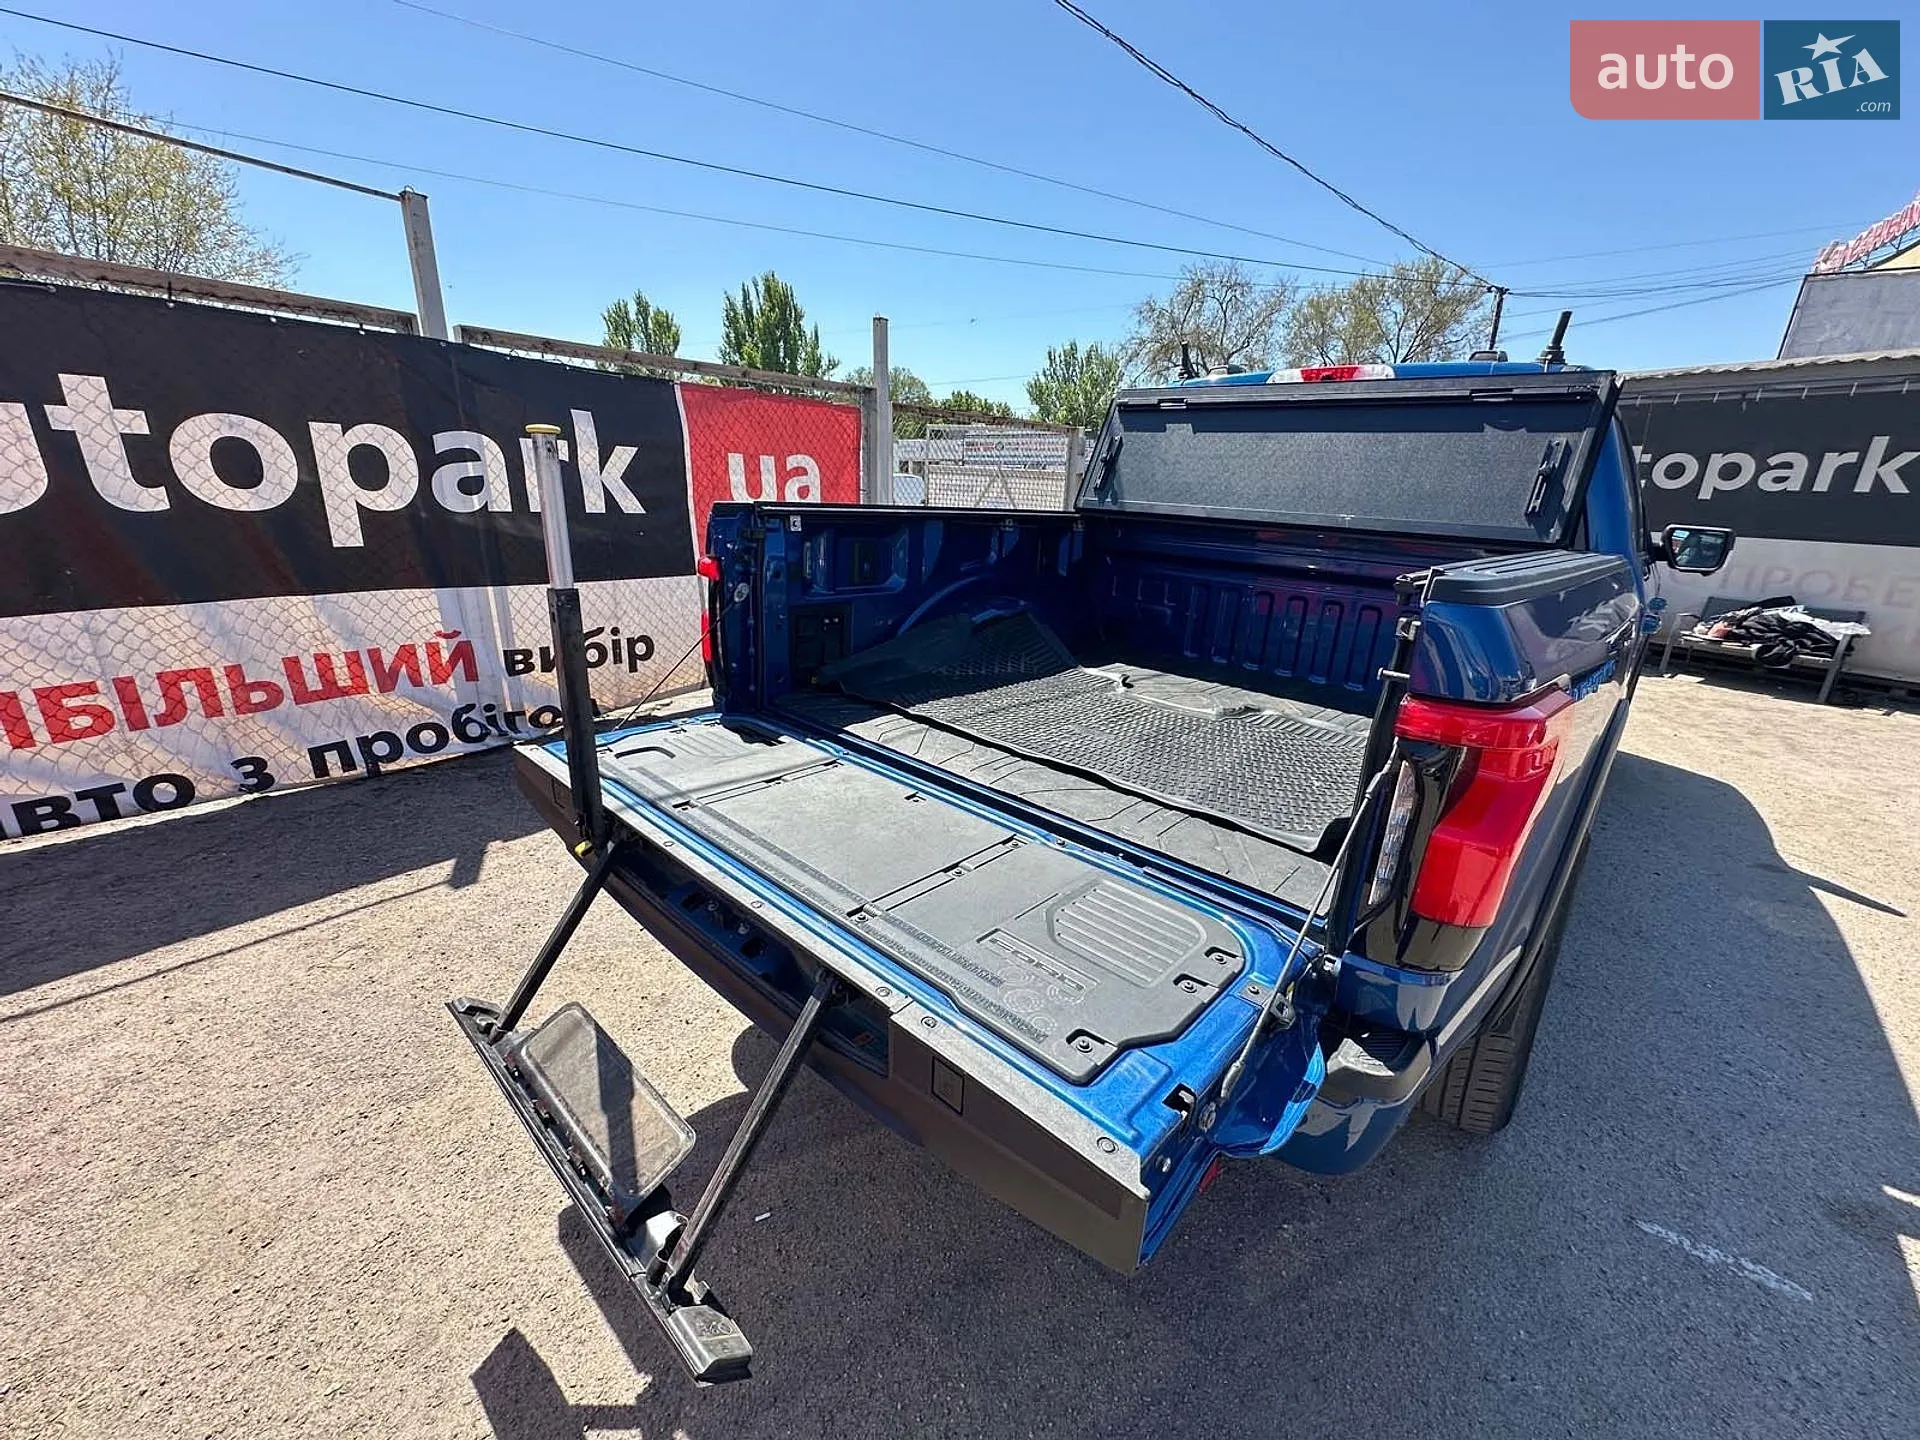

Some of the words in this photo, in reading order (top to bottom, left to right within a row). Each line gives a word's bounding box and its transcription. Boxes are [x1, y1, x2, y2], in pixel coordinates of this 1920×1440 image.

[726, 453, 822, 503] ua
[0, 772, 196, 842] вто
[308, 698, 601, 780] пробіго
